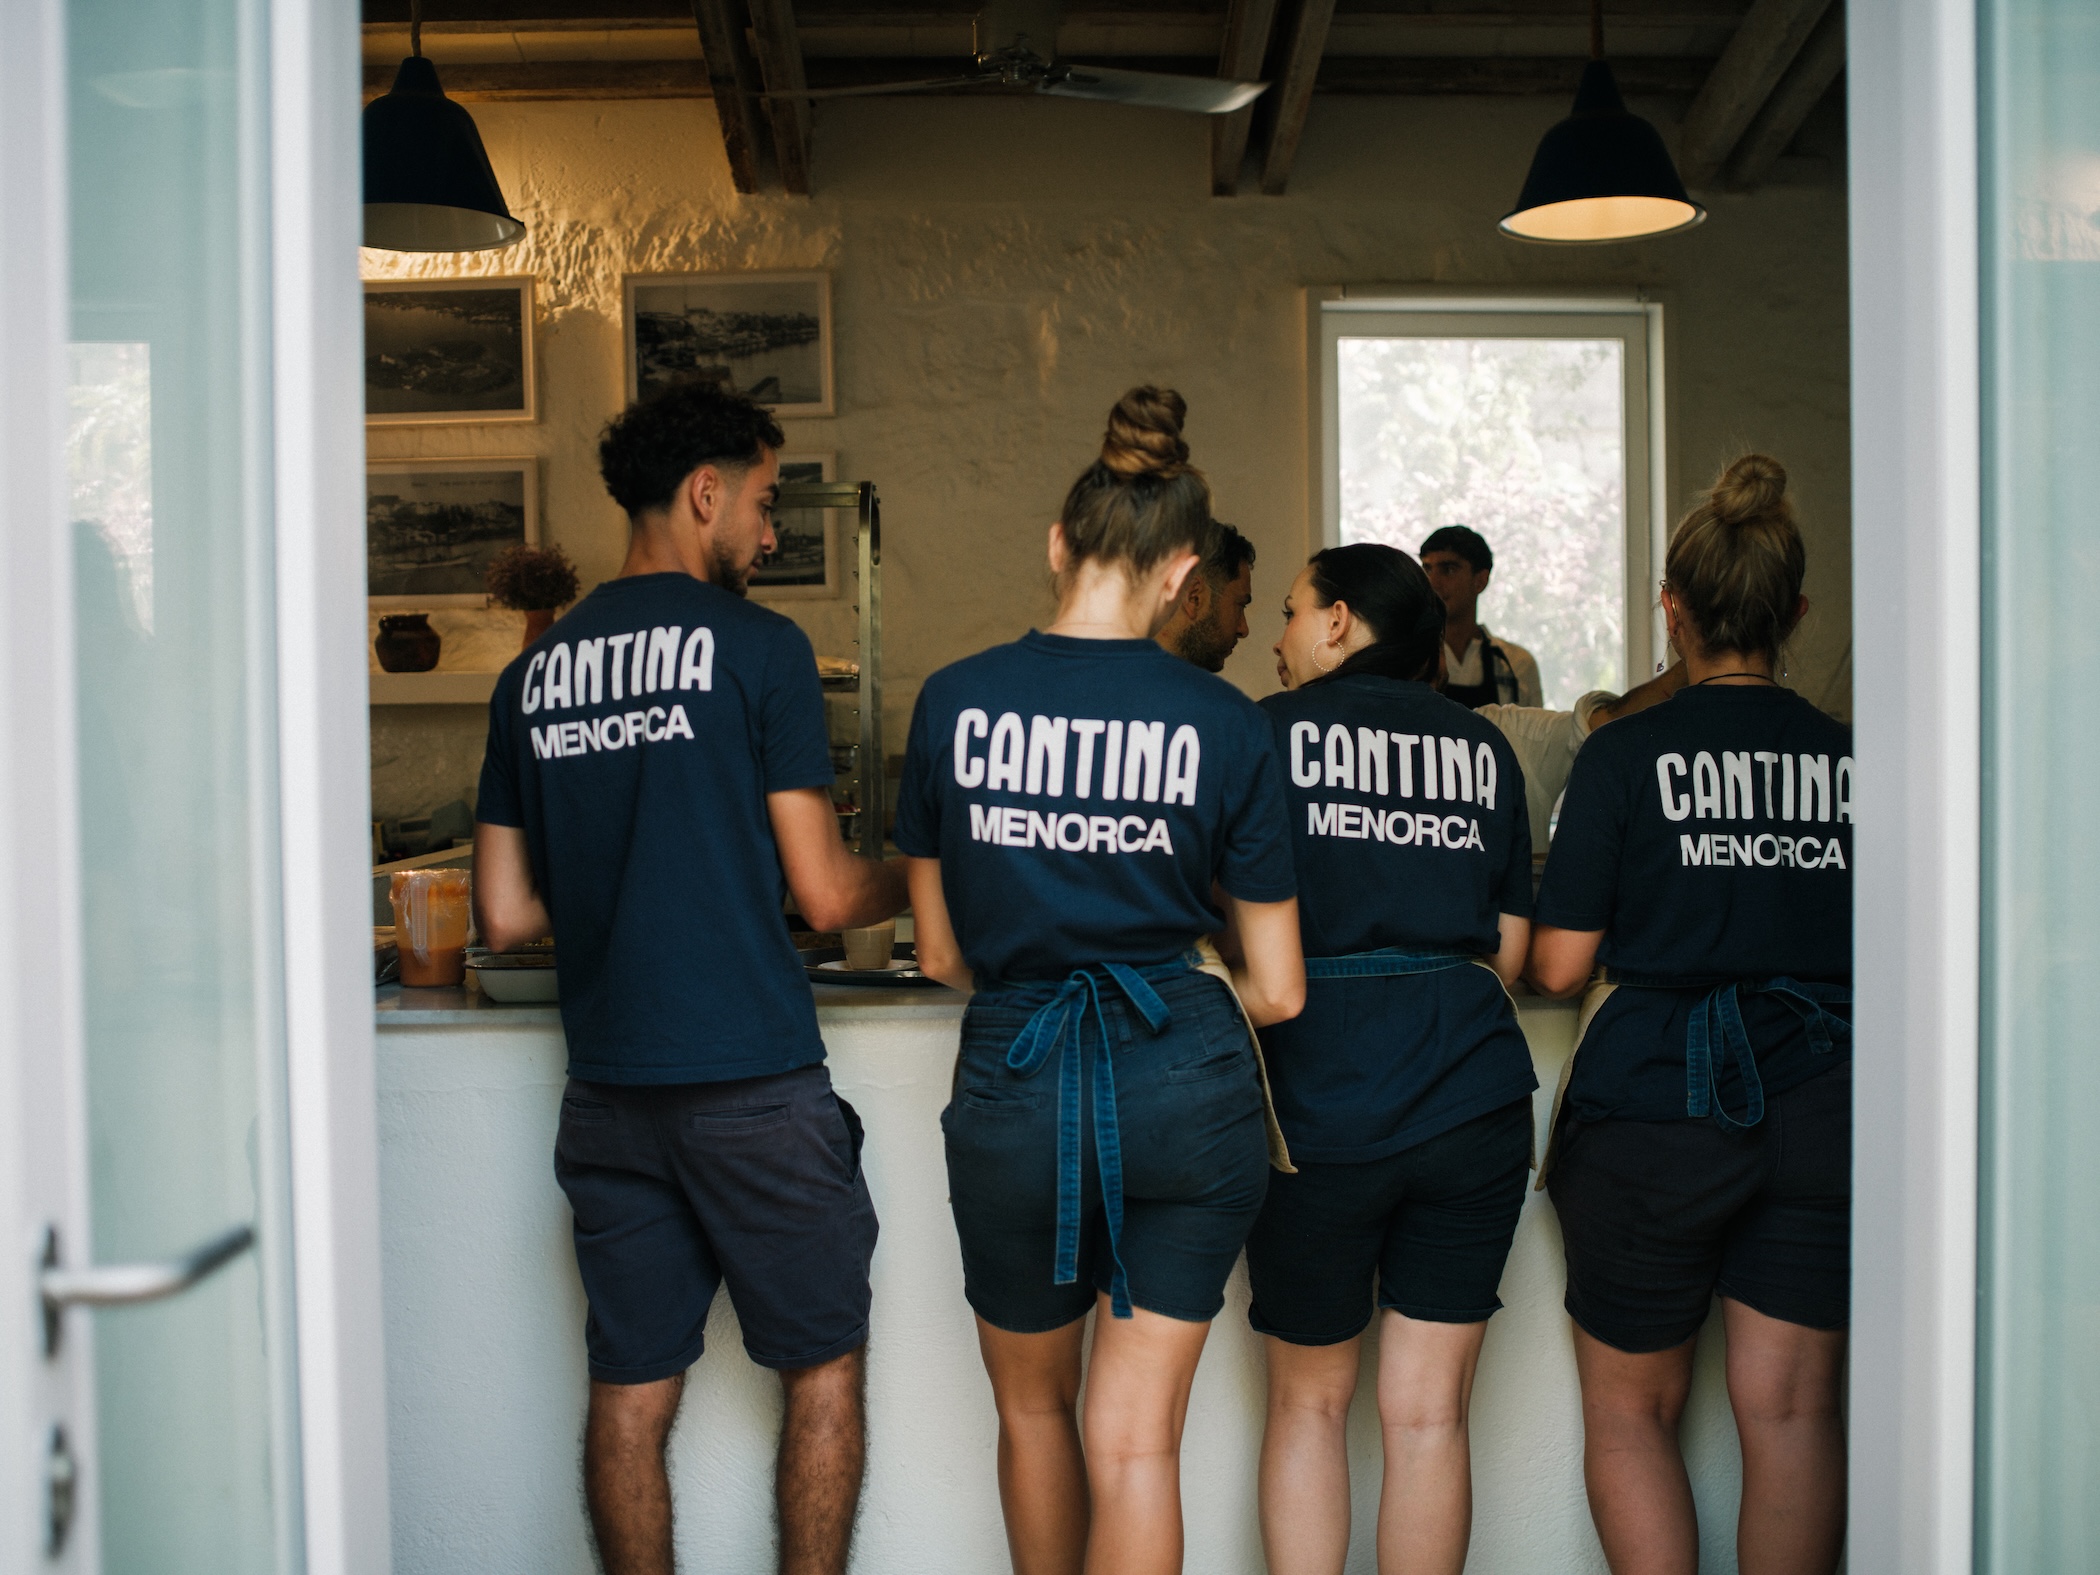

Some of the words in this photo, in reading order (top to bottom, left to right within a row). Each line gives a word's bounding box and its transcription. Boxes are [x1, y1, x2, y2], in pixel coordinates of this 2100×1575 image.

[521, 625, 716, 715] CANTINA
[530, 704, 695, 760] MENORCA
[953, 707, 1201, 807] CANTINA
[1290, 720, 1498, 811] CANTINA
[1655, 750, 1855, 825] CANTINA
[969, 803, 1174, 856] MENORCA
[1307, 802, 1486, 852] MENORCA
[1679, 833, 1848, 870] MENORCA
